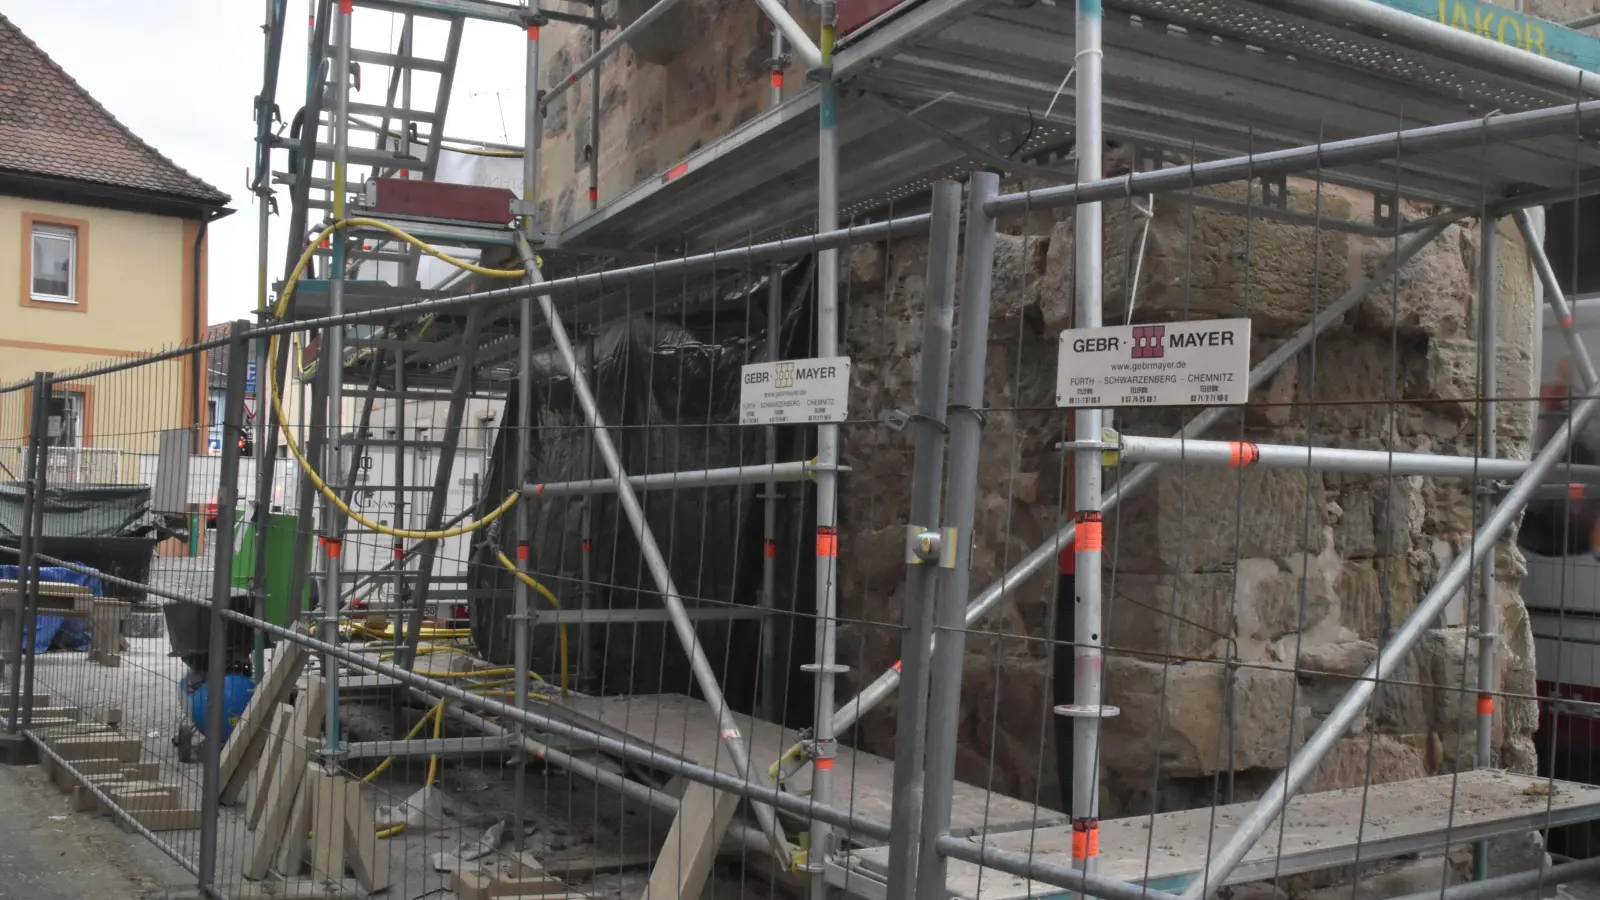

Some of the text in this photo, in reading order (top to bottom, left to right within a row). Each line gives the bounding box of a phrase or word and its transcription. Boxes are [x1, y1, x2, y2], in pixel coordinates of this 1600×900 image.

[1073, 331, 1234, 353] GEBR MAYER
[1111, 361, 1187, 372] www.gebrmayer.de
[744, 366, 836, 384] GEBR MAYER
[1070, 376, 1095, 386] FÜRTH
[1104, 375, 1177, 385] SCHWARZENBERG
[1187, 373, 1234, 383] CHEMNITZ
